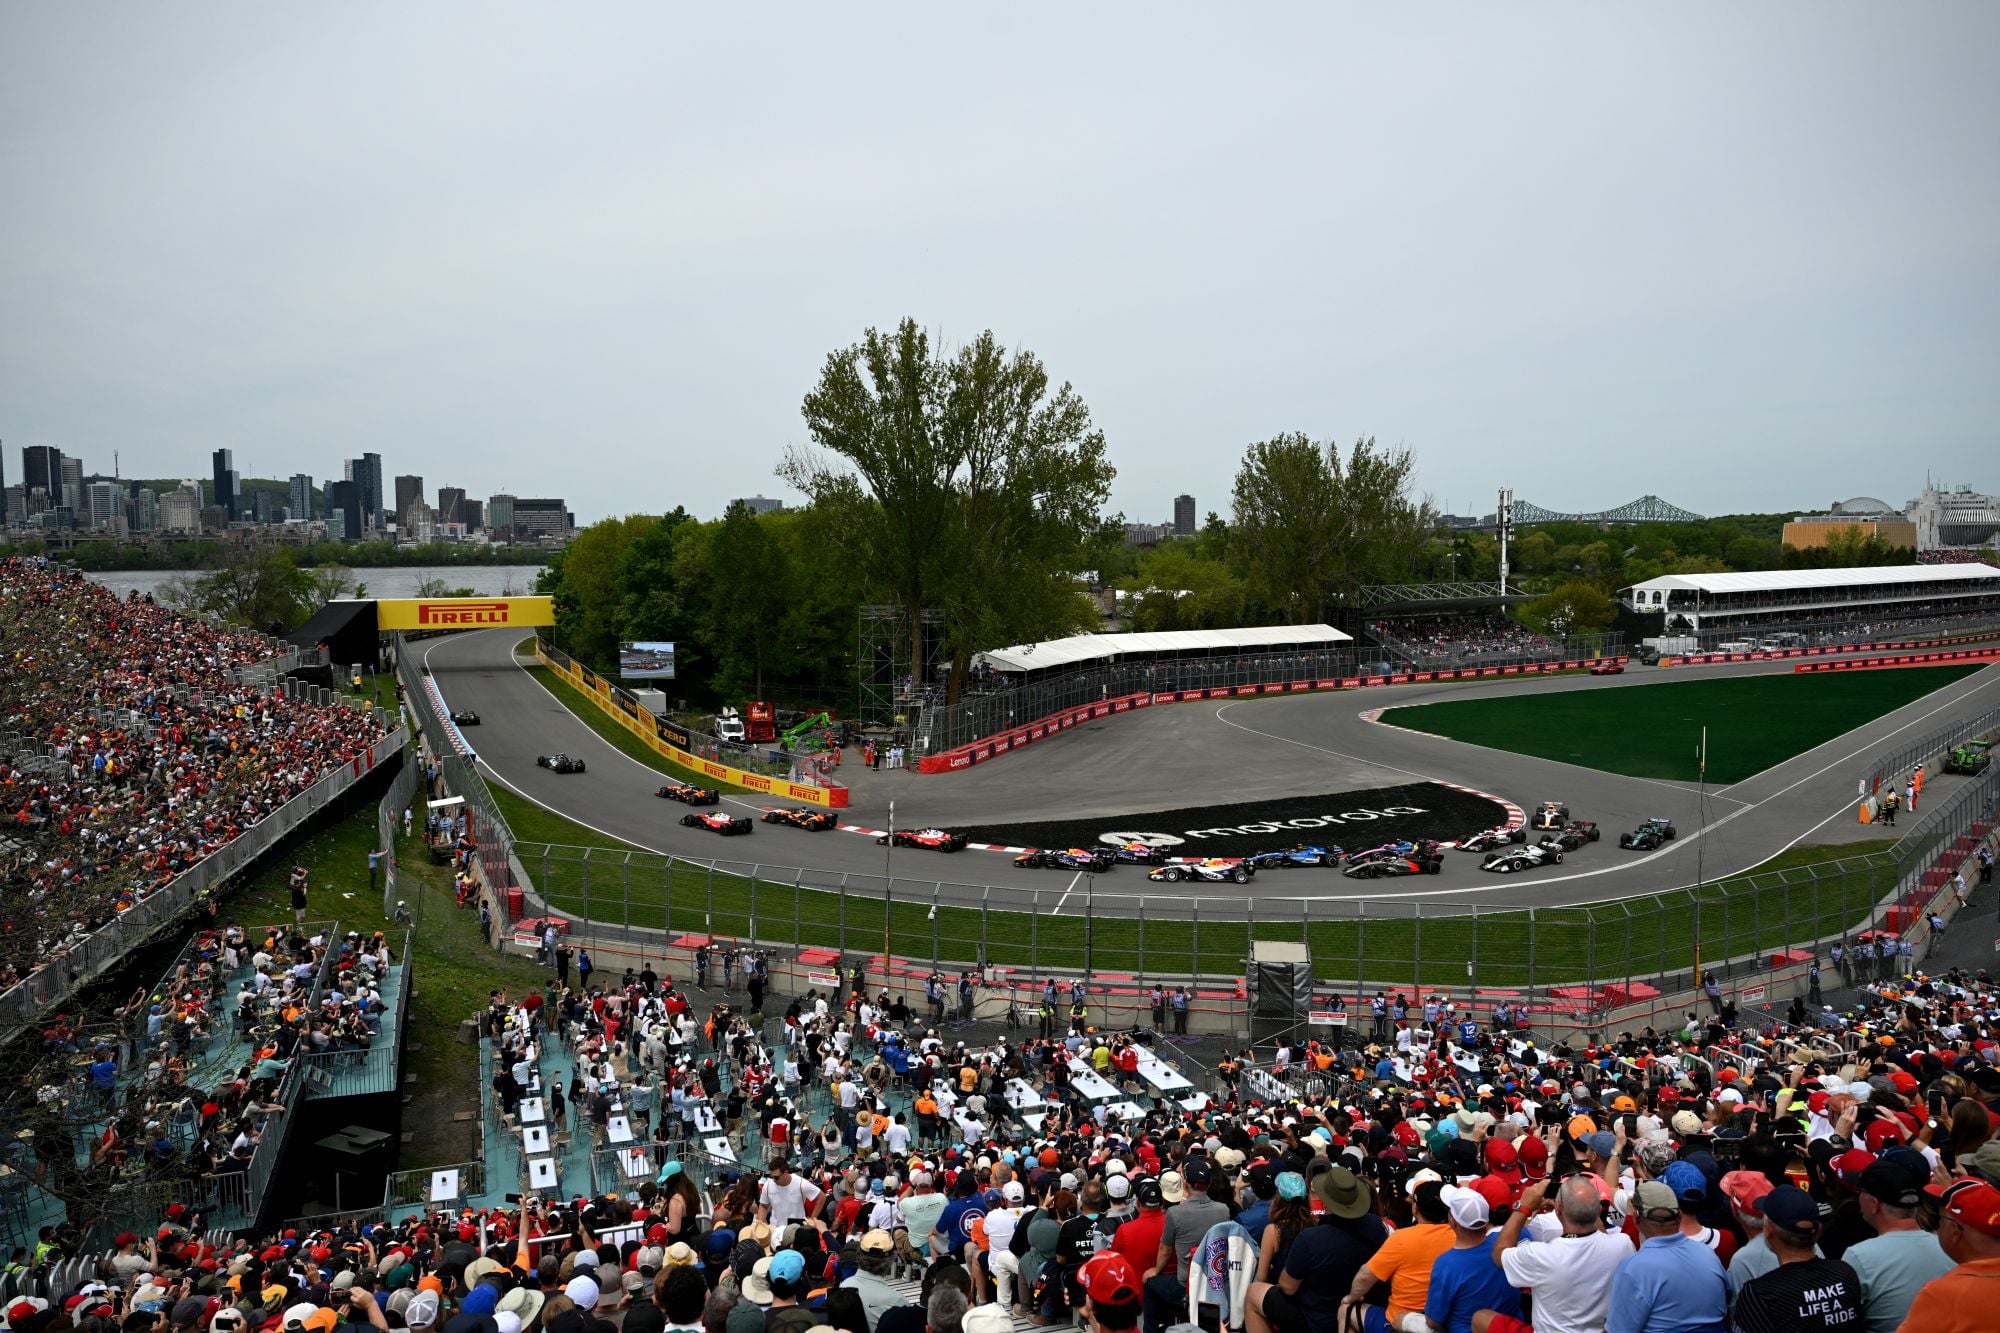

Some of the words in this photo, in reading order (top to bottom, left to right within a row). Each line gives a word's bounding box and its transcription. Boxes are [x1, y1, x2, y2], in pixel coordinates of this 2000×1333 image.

[419, 603, 509, 624] PIRELLI
[663, 728, 686, 746] ZERO
[950, 756, 970, 767] Lenovo
[704, 763, 726, 779] PIRELLI
[742, 774, 770, 790] PIRELLI
[790, 784, 820, 802] PIRELLI
[1186, 806, 1430, 839] motorola
[1465, 1026, 1476, 1035] 12
[1803, 1282, 1845, 1302] MAKE
[1799, 1302, 1830, 1317] LIFE
[1833, 1299, 1842, 1310] A
